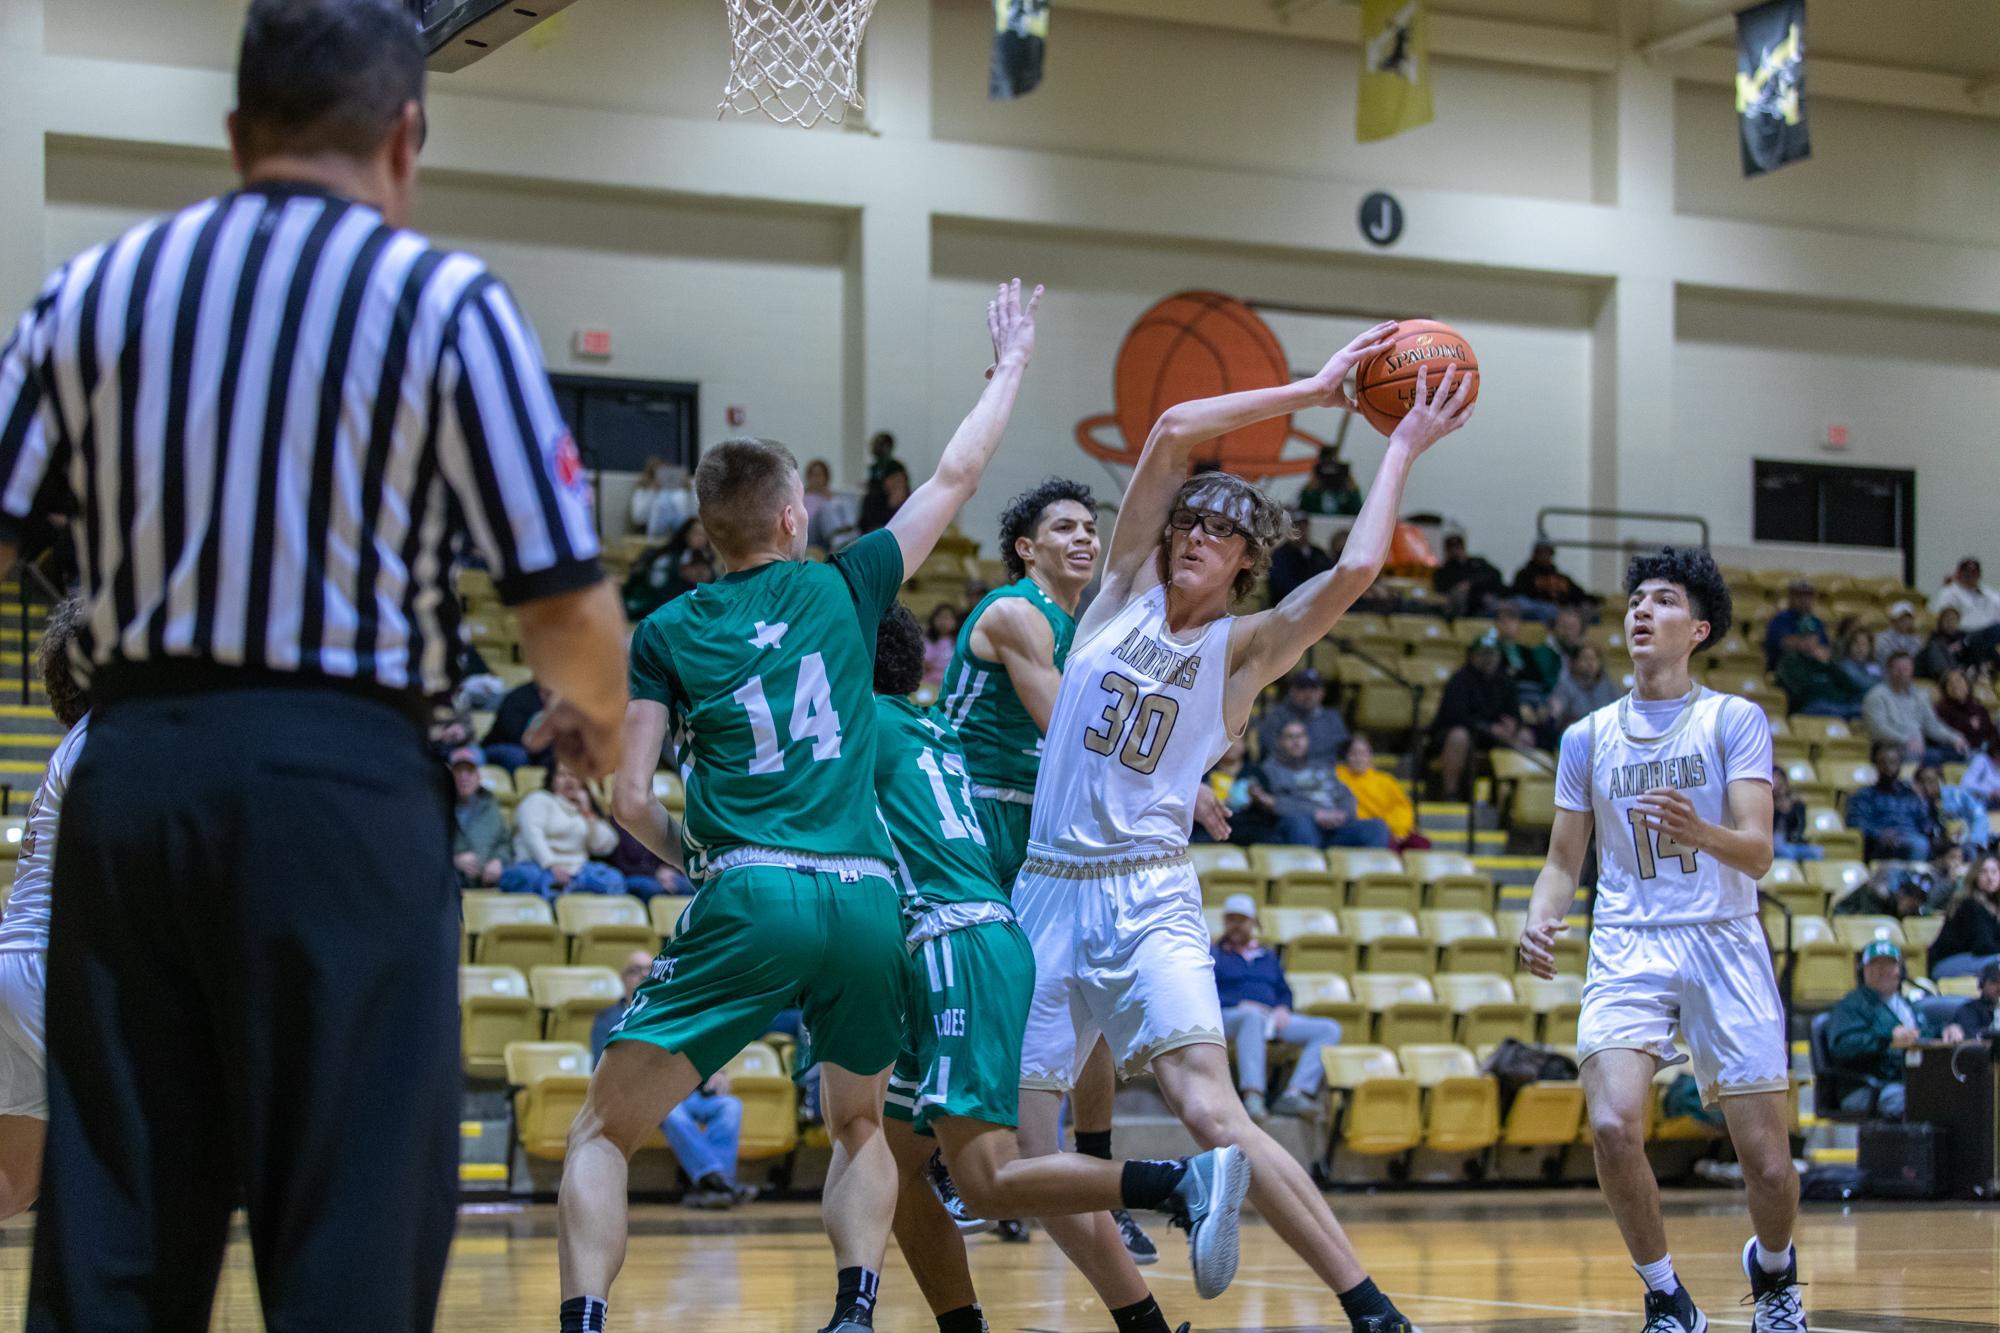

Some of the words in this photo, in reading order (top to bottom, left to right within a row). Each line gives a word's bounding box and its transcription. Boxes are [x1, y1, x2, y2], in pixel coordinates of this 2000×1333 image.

[1370, 200, 1391, 240] J
[1385, 343, 1466, 375] SPALDING
[733, 651, 842, 775] 14
[1084, 671, 1179, 775] 30
[916, 746, 986, 846] 13
[1609, 753, 1707, 800] ANDREWS
[1627, 808, 1698, 879] 14
